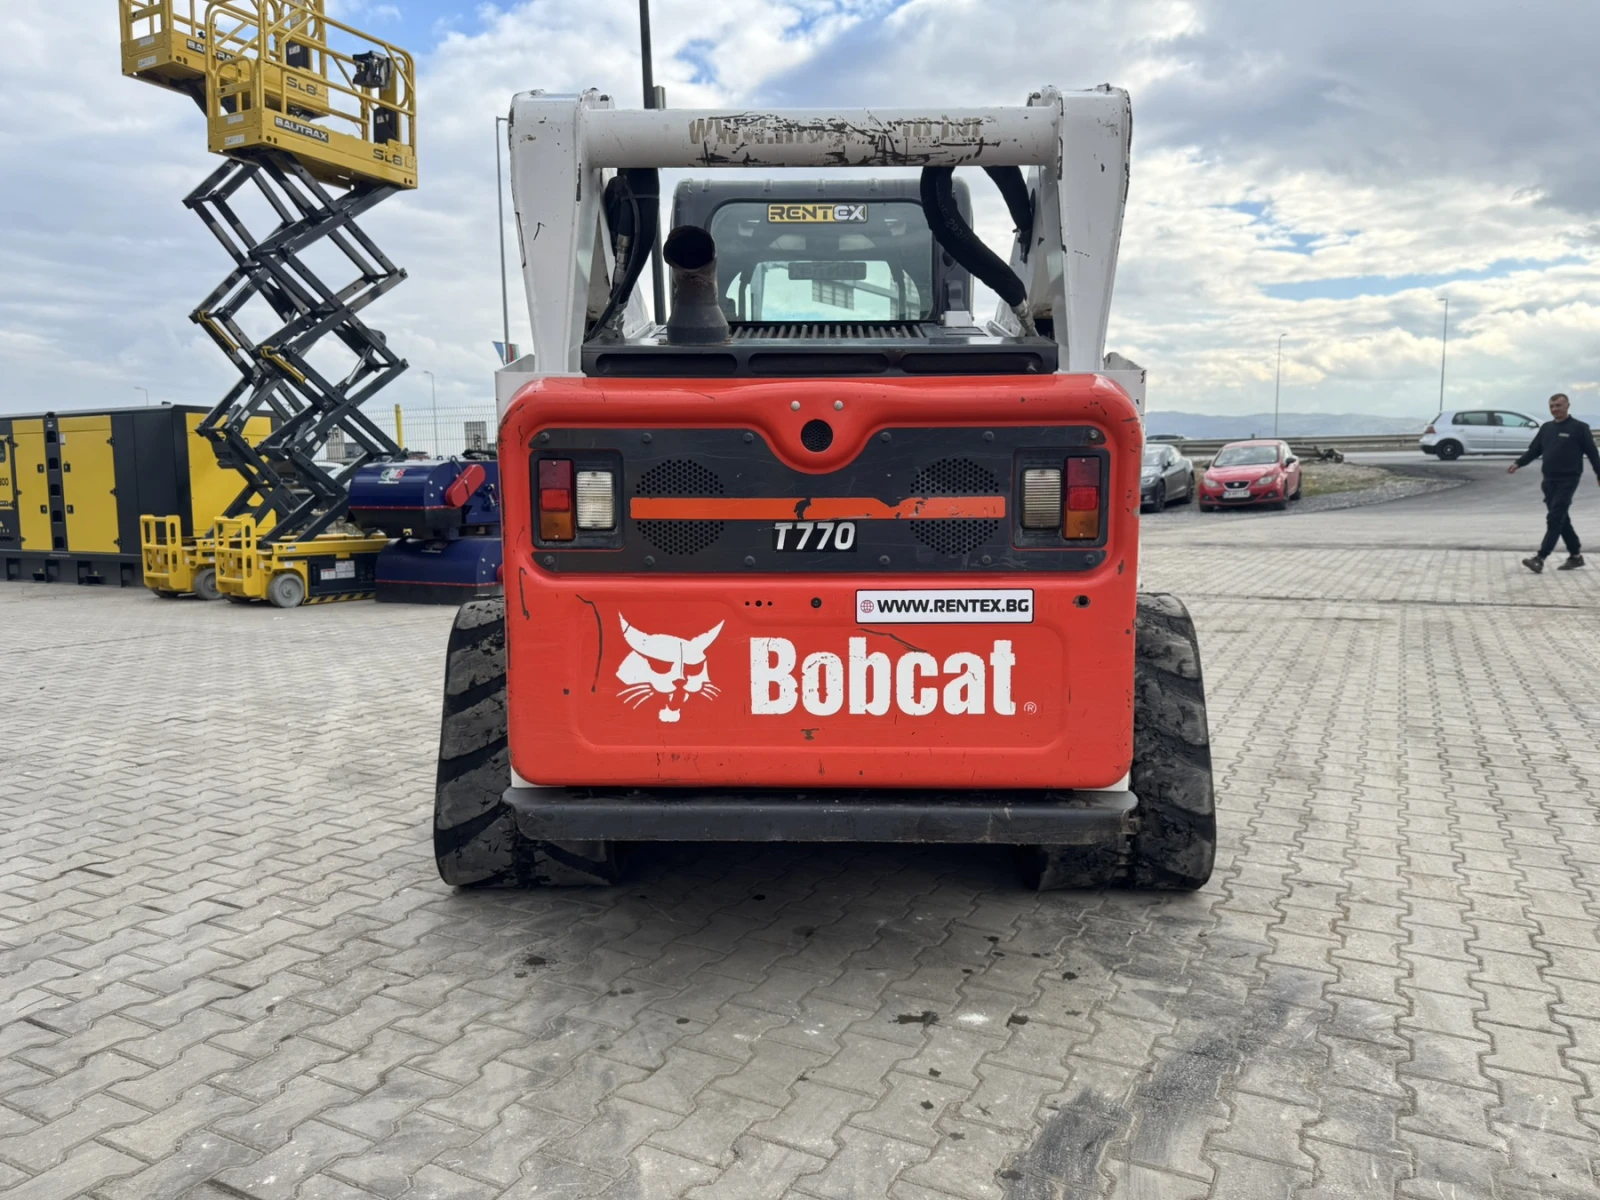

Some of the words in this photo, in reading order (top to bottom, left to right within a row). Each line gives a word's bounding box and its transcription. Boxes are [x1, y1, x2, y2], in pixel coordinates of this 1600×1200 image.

[275, 117, 328, 141] BAUTRAX
[770, 205, 865, 220] RENTEX
[774, 522, 856, 550] T770
[877, 599, 1029, 613] WWW.RENTEX.BG
[750, 636, 1016, 716] Bobcat
